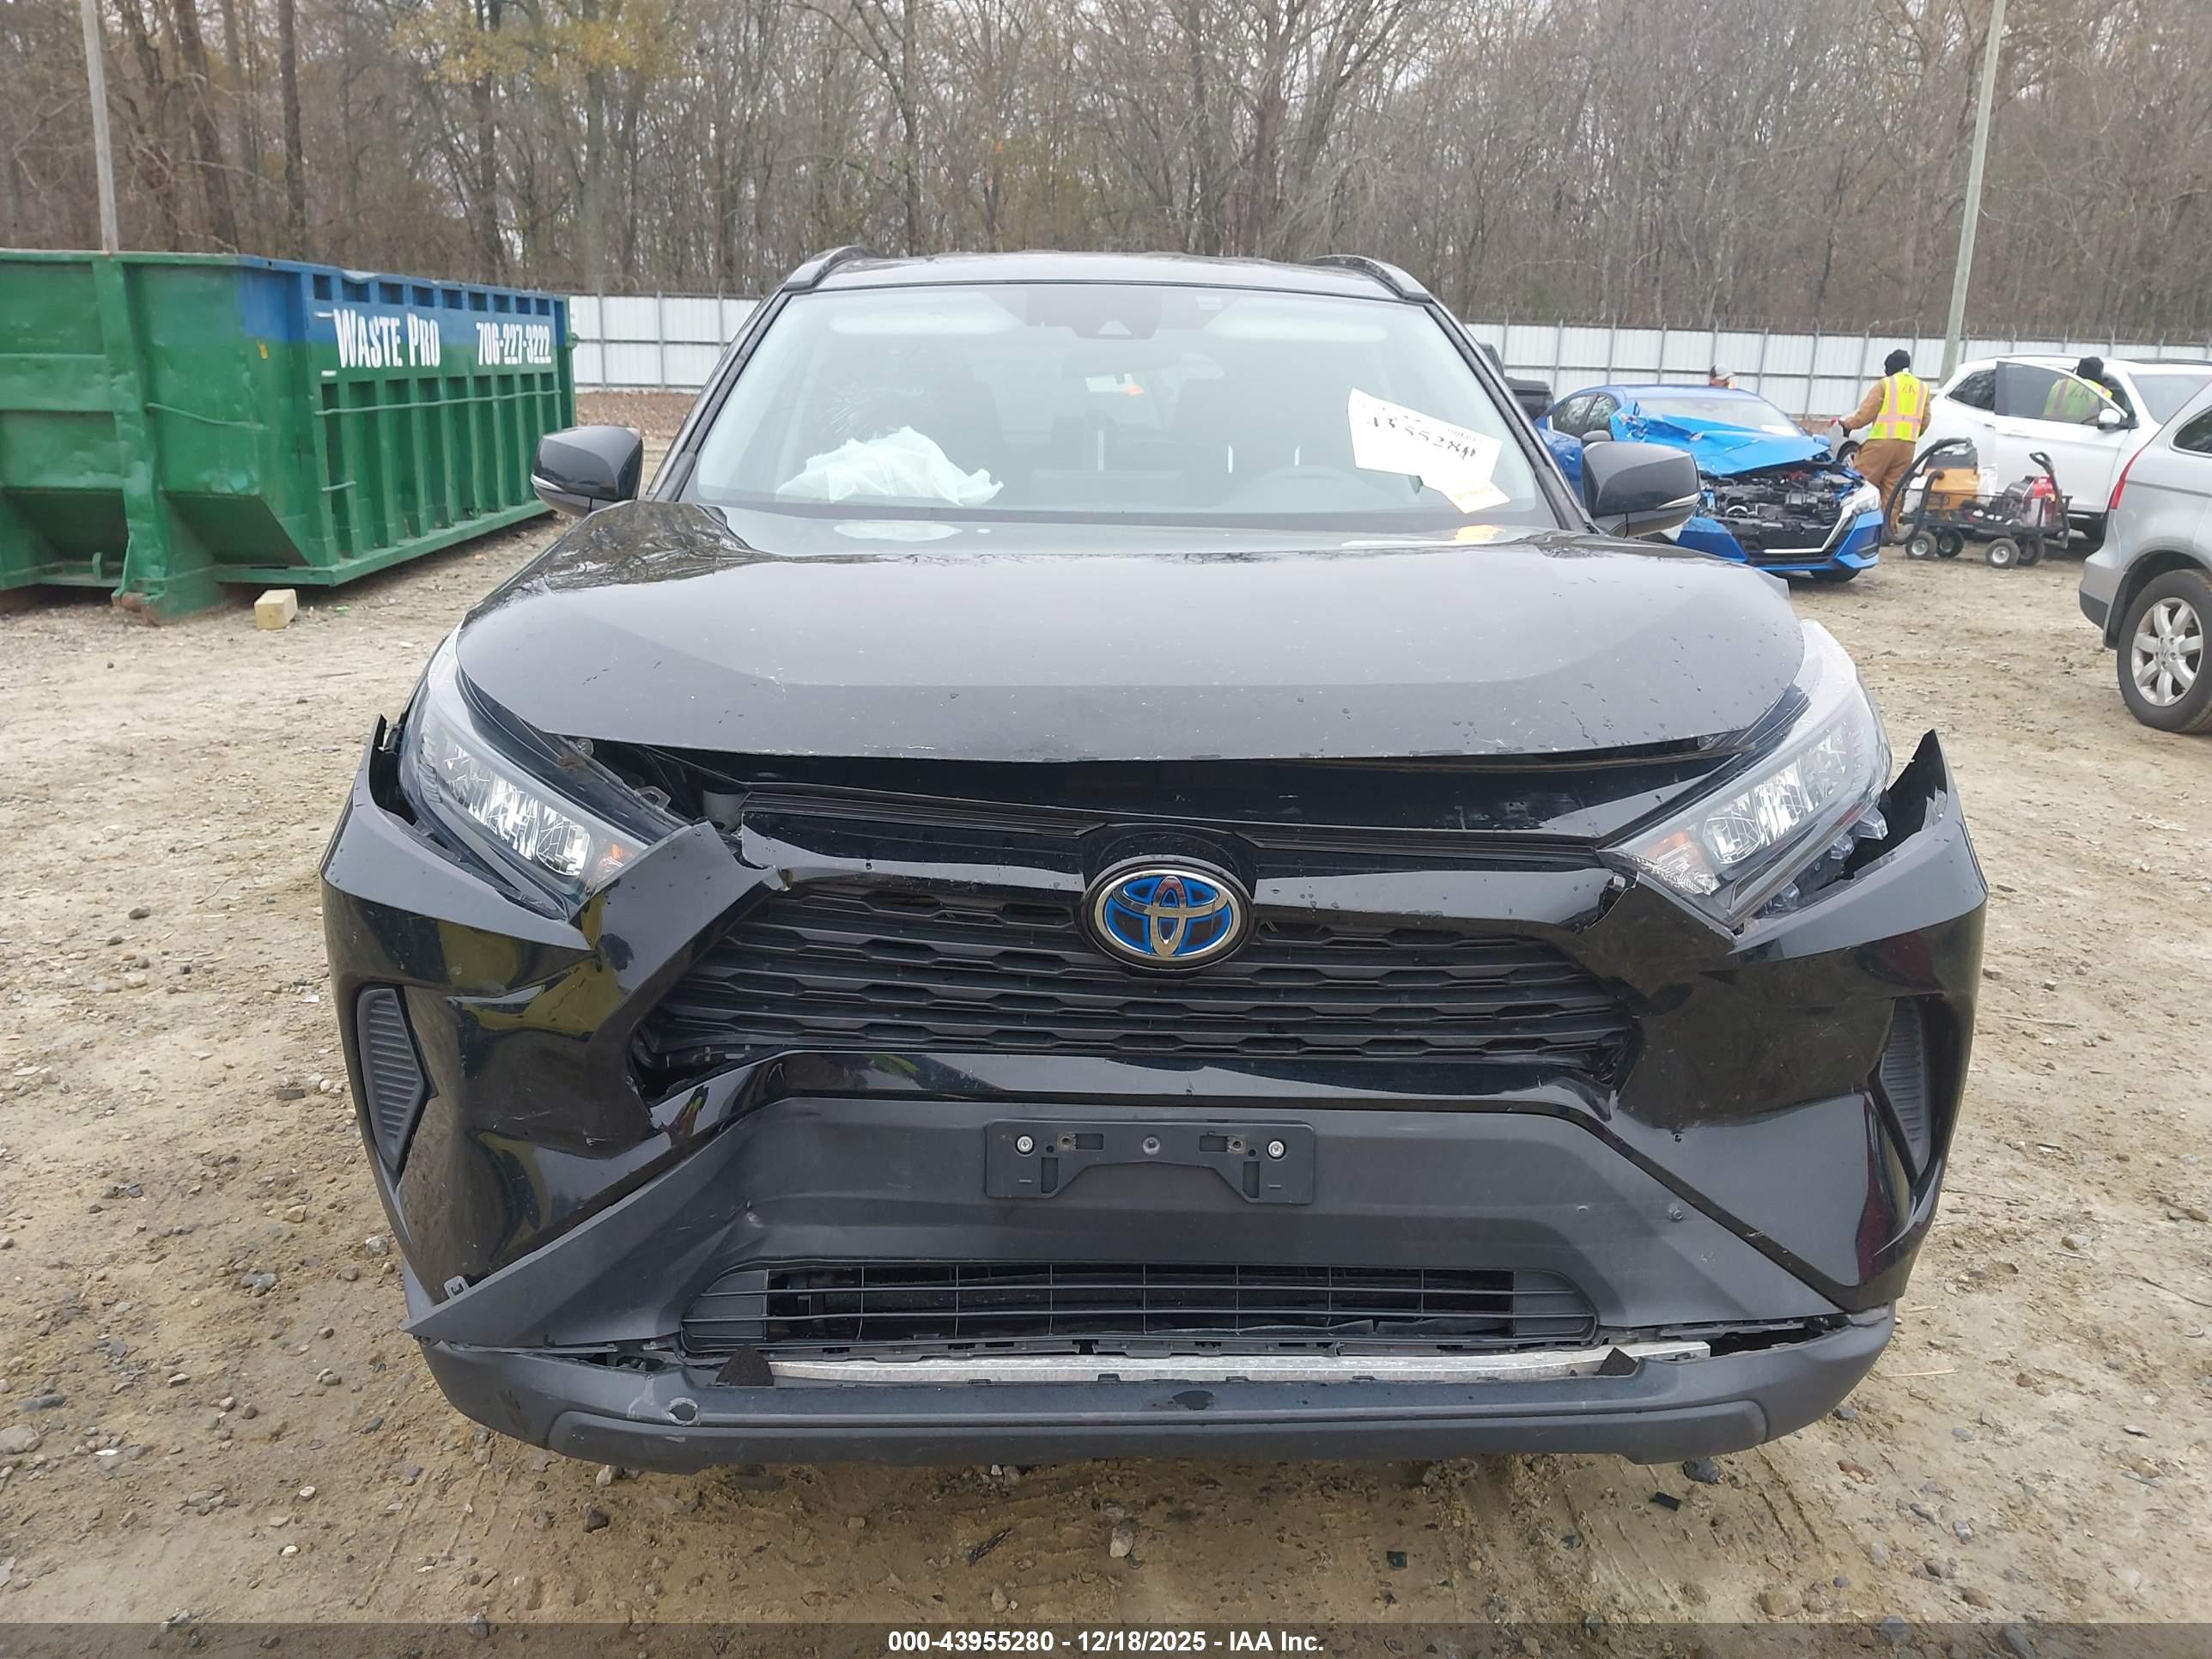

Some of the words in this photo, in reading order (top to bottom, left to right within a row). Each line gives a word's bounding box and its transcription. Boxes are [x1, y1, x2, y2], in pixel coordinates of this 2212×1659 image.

[333, 308, 403, 368] WASTE
[407, 313, 441, 367] PRO
[476, 322, 551, 366] 706-227-3222
